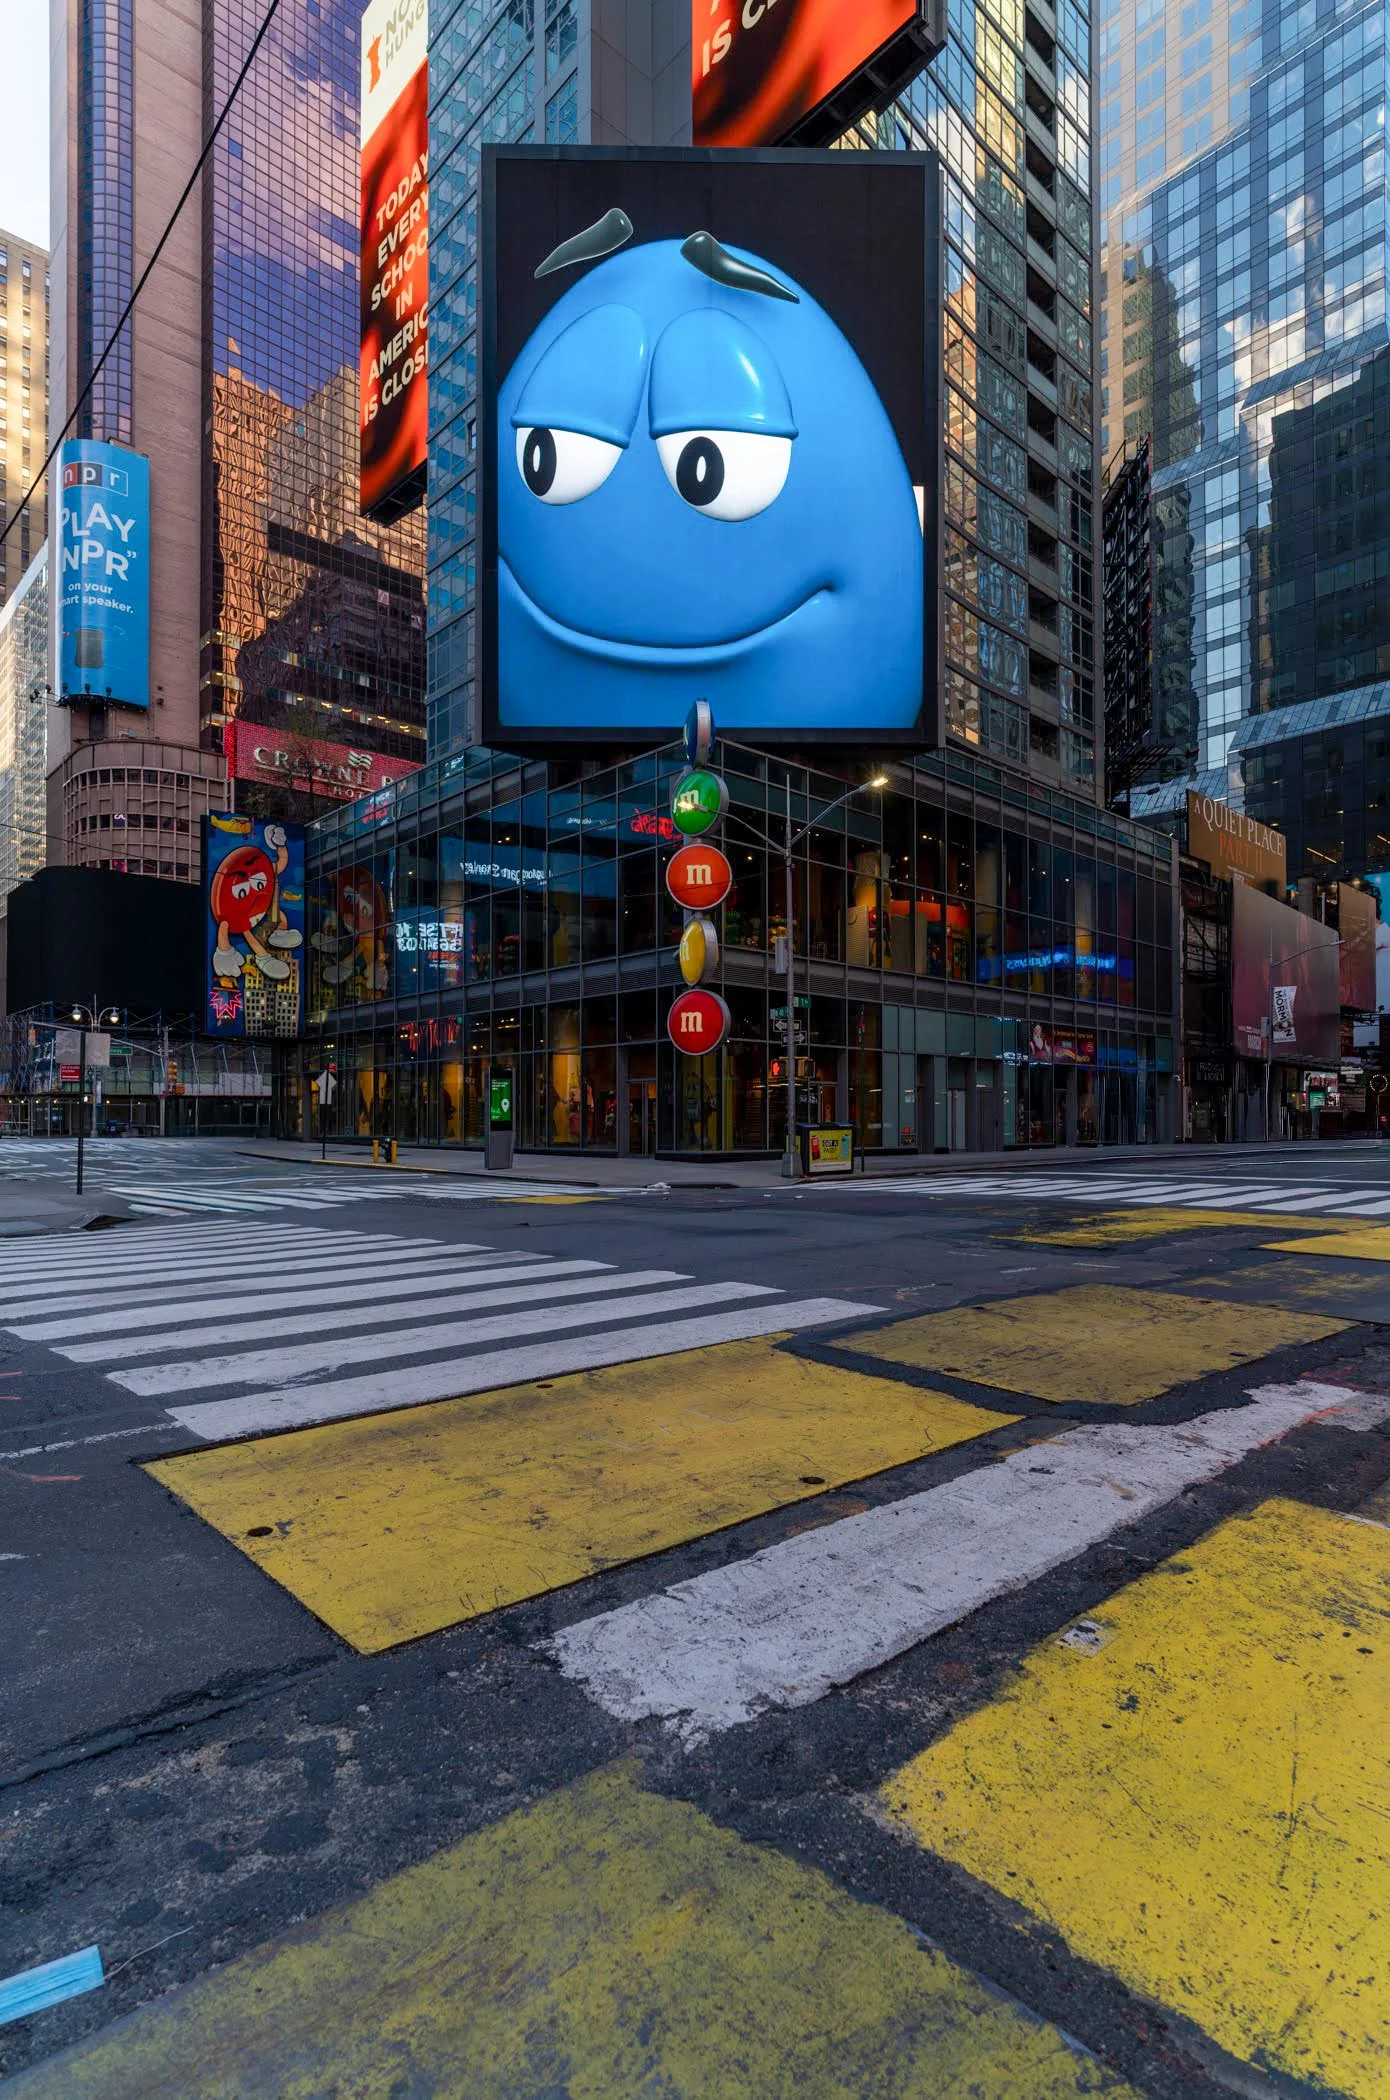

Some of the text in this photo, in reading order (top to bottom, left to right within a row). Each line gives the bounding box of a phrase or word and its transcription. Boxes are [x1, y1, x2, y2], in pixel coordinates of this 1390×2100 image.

[703, 19, 732, 77] IS
[395, 281, 413, 320] IN
[364, 394, 378, 427] IS
[64, 466, 120, 486] npr
[68, 582, 113, 594] on your
[82, 594, 134, 614] speaker.
[1194, 797, 1284, 857] A QUIET PLACE
[1219, 832, 1250, 868] PART
[686, 864, 712, 885] m
[681, 1012, 703, 1033] m
